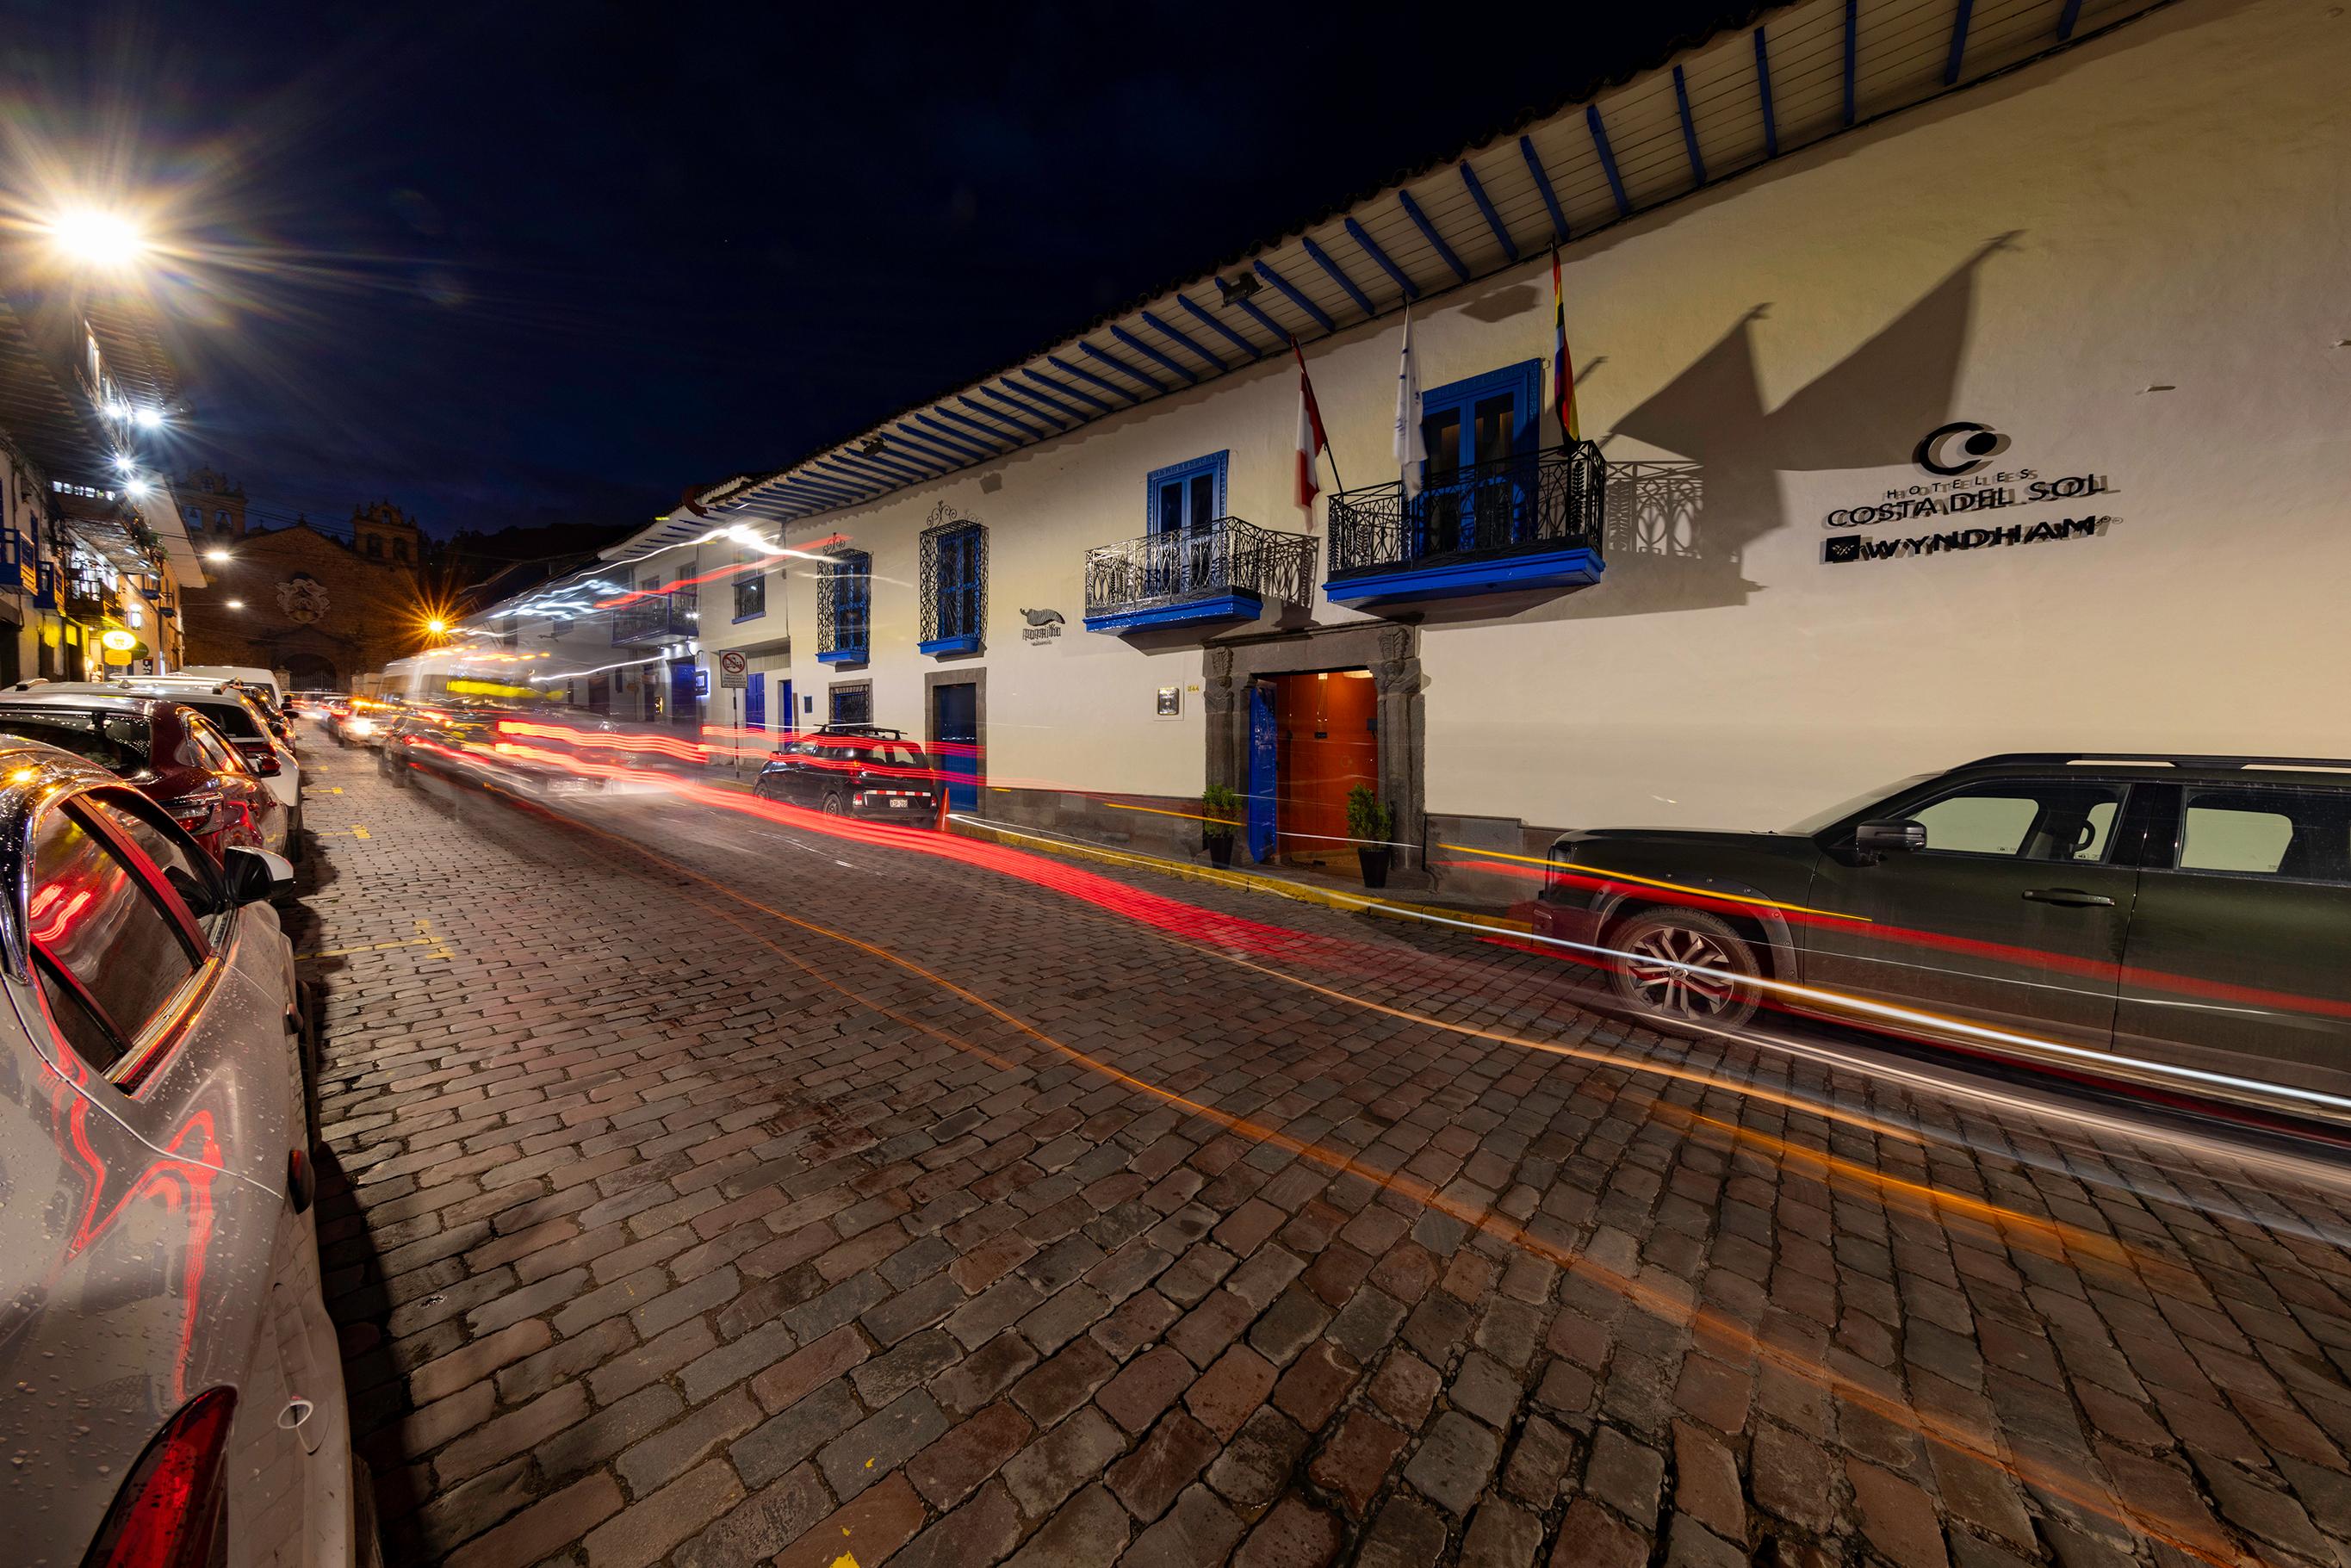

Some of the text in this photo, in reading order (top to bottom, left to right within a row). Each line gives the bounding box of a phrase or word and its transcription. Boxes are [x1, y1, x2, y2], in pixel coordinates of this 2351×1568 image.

[1827, 474, 2106, 527] COSTA DEL SOL
[1887, 468, 2030, 499] HOTELES
[1865, 515, 2096, 559] WYNDHAM
